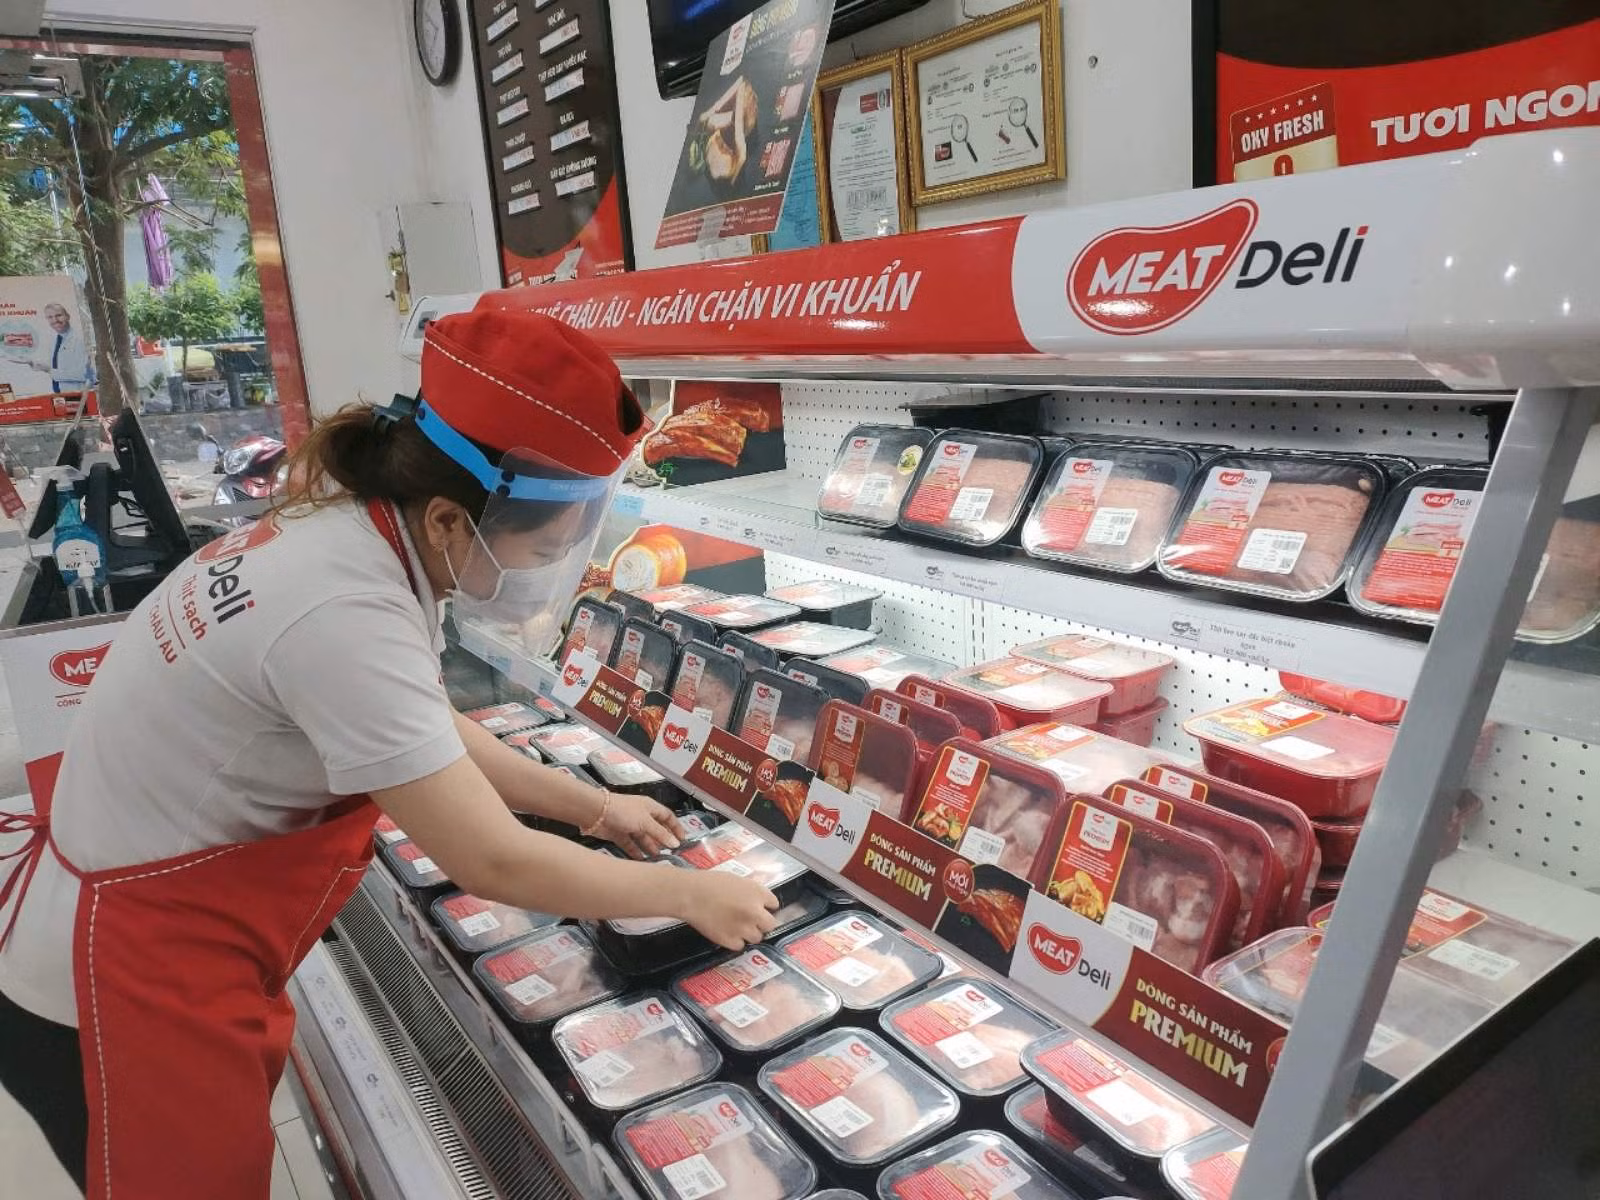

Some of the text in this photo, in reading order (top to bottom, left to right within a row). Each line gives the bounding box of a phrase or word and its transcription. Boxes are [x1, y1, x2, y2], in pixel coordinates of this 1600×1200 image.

[1241, 109, 1325, 153] OXY FRESH
[1371, 103, 1470, 147] TƯƠI
[1087, 225, 1369, 297] MEAT Deli
[599, 295, 630, 328] ÂU
[636, 289, 701, 326] NGĂN
[699, 281, 771, 331] CHẶN
[770, 283, 803, 319] VI
[800, 259, 922, 317] KHUẨN
[1425, 495, 1452, 504] MEAT
[208, 555, 255, 624] Deli
[182, 600, 208, 641] sạch
[64, 657, 99, 677] ME
[666, 730, 684, 745] MEAT
[701, 756, 749, 793] PREMIUM
[809, 811, 856, 845] MEAT Deli
[864, 848, 933, 902] PREMIUM
[949, 870, 970, 890] MỚI
[1034, 933, 1111, 990] MEAT Deli
[1136, 978, 1254, 1055] DÒNG SẢN PHẨM
[1130, 998, 1249, 1088] PREMIUM
